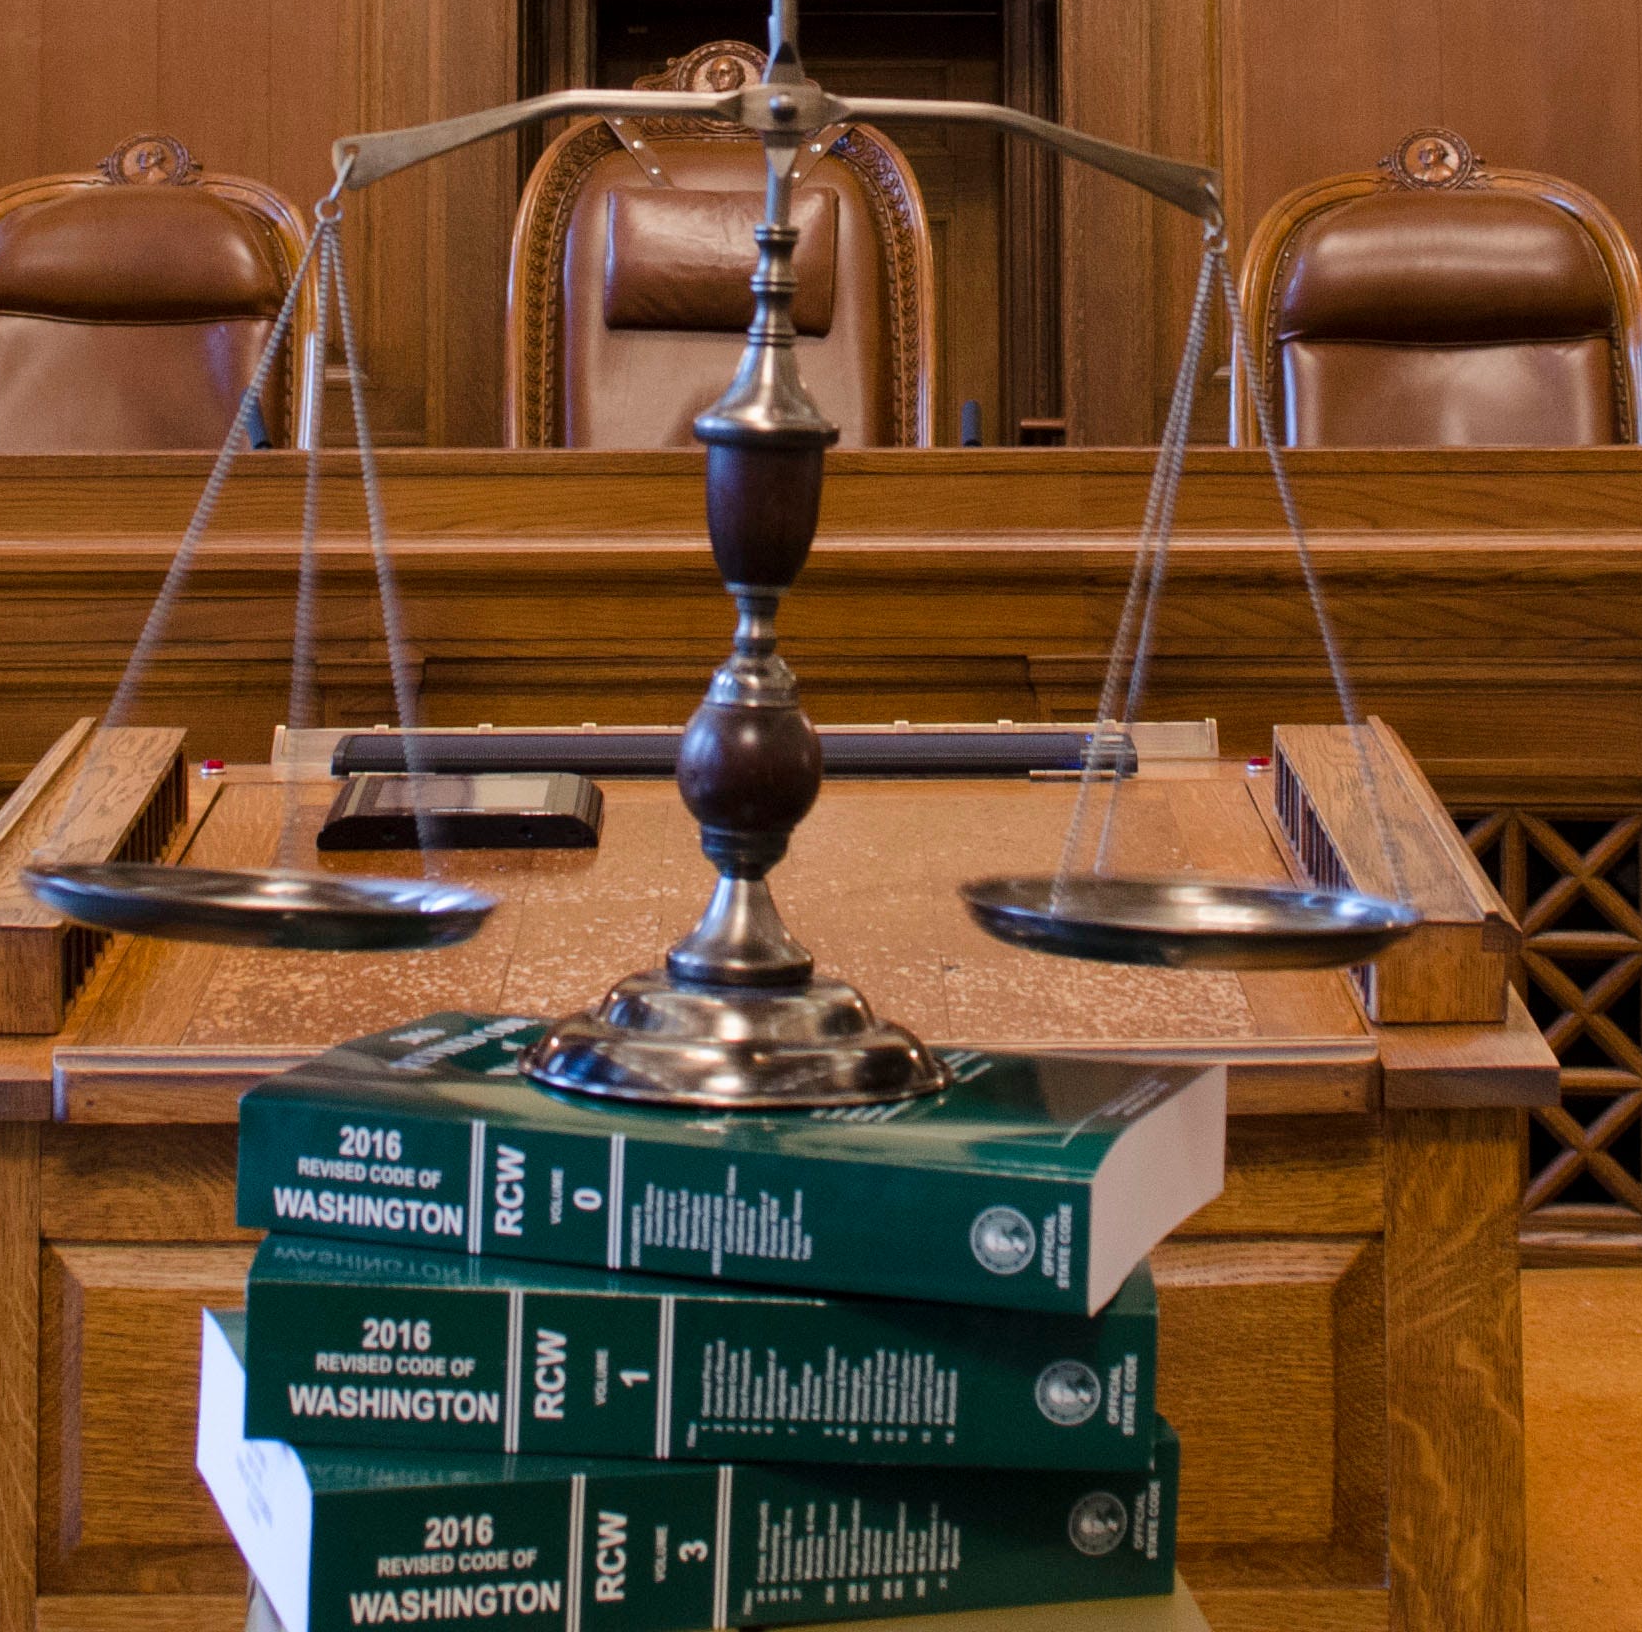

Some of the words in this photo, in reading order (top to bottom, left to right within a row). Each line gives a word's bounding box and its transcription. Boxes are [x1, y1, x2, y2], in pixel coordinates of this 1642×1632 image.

[339, 1125, 403, 1161] 2016
[297, 1156, 367, 1183] REVISED
[370, 1163, 415, 1187] CODE
[418, 1169, 443, 1190] OF
[494, 1144, 526, 1237] RCW
[273, 1186, 464, 1236] WASHINGTON
[550, 1168, 564, 1226] VOLUME
[573, 1187, 603, 1212] 0
[1058, 1203, 1072, 1244] CODE
[1041, 1213, 1057, 1277] OFFICIAL
[1057, 1246, 1071, 1290] STATE
[361, 1318, 432, 1351] 2016
[315, 1352, 392, 1375] REVISED
[395, 1354, 445, 1376] CODE
[450, 1358, 476, 1378] OF
[534, 1328, 567, 1420] RCW
[594, 1348, 609, 1406] VOLUME
[619, 1369, 651, 1388] 1
[1124, 1352, 1138, 1393] CODE
[288, 1383, 500, 1423] WASHINGTON
[1108, 1364, 1122, 1425] OFFICIAL
[1122, 1393, 1136, 1436] STATE
[1133, 1490, 1147, 1550] OFFICIAL
[1148, 1480, 1161, 1518] CODE
[424, 1513, 494, 1549] 2016
[678, 1539, 708, 1563] 3
[1146, 1519, 1159, 1560] STATE
[377, 1551, 455, 1578] REVISED
[458, 1549, 509, 1572] CODE
[512, 1548, 538, 1569] OF
[596, 1511, 628, 1602] RCW
[349, 1580, 562, 1625] WASHINGTON
